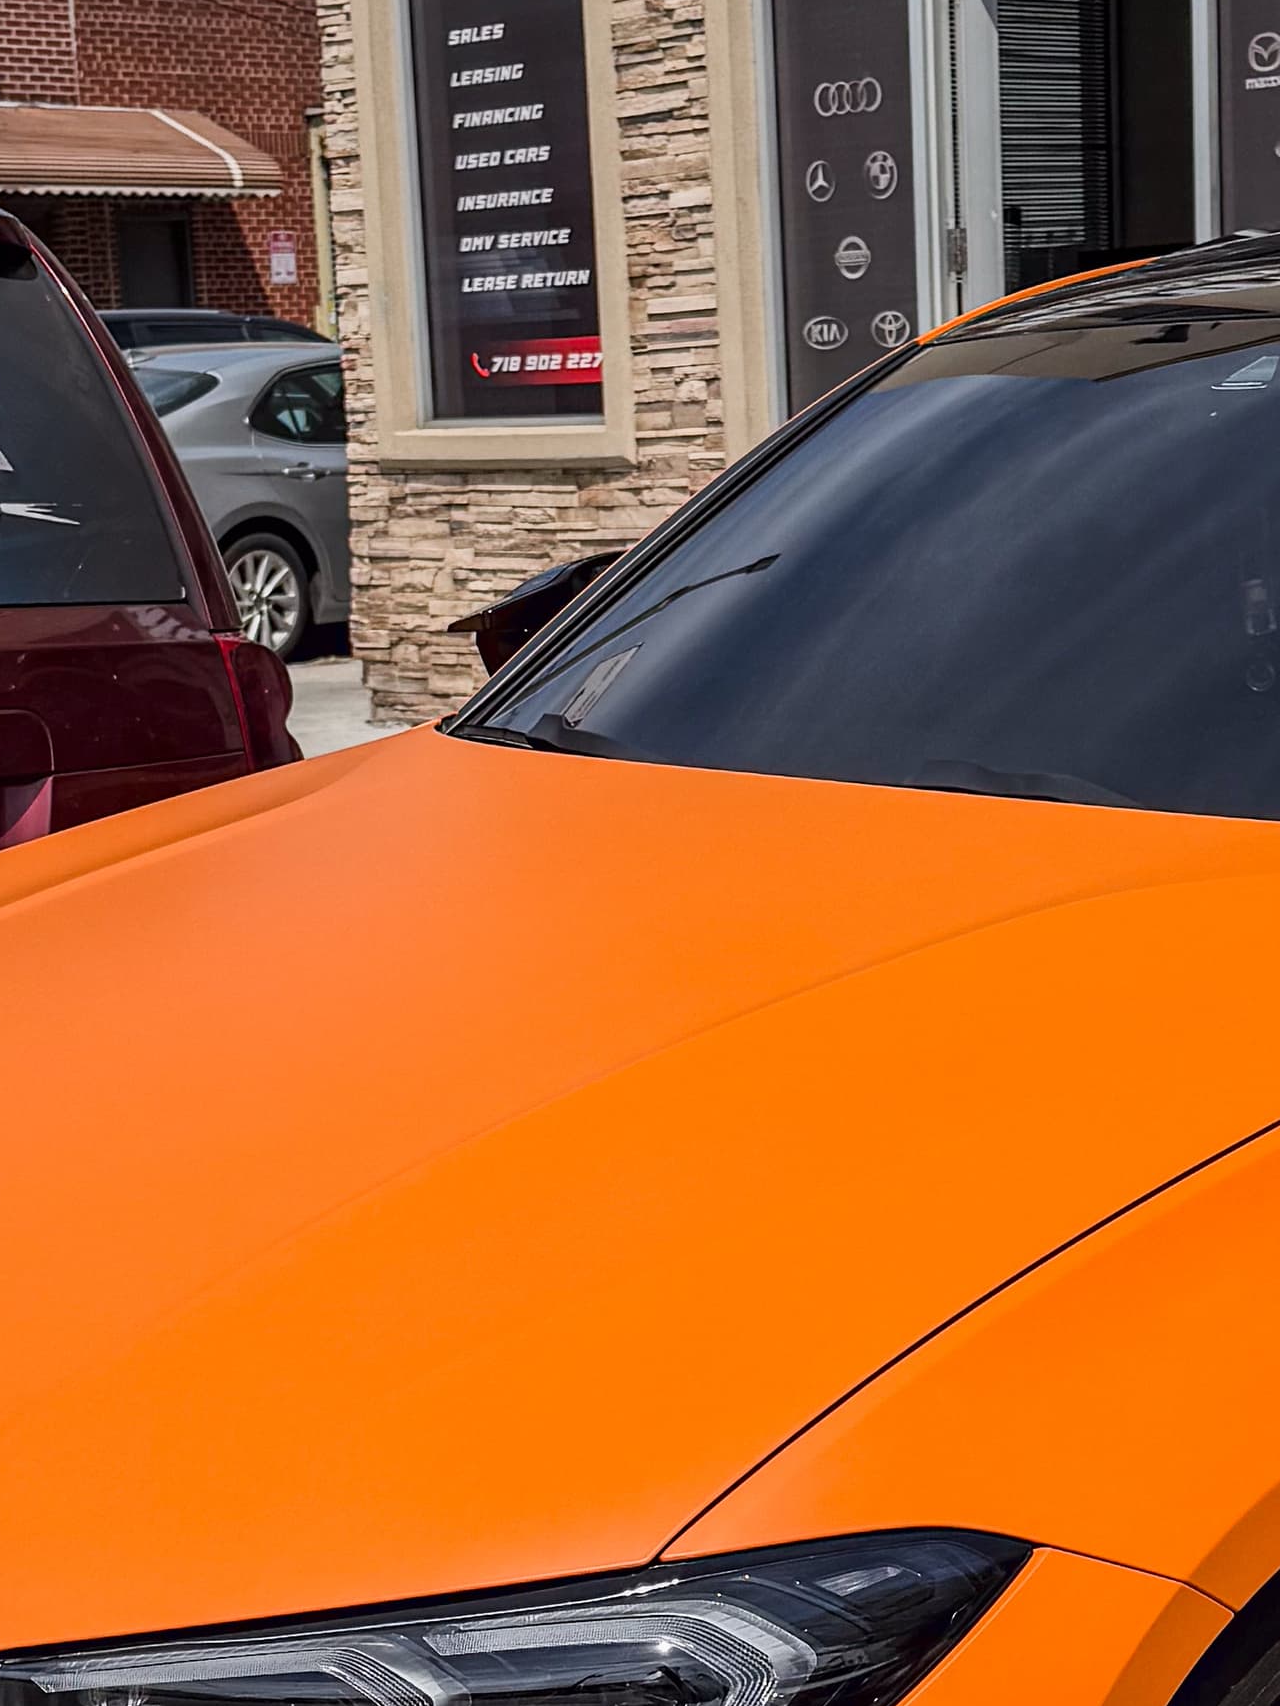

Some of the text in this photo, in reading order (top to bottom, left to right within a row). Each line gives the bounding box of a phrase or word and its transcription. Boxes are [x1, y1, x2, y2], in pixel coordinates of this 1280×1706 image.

[448, 24, 505, 46] SALES
[450, 63, 524, 88] LEASING
[452, 103, 544, 129] FINANCING
[454, 145, 551, 171] USED CARS
[457, 187, 554, 212] INSURANCE
[459, 228, 571, 253] DMV SERVICE
[461, 269, 590, 293] LEASE RETURN
[490, 355, 521, 373] 718
[524, 353, 562, 372] 902
